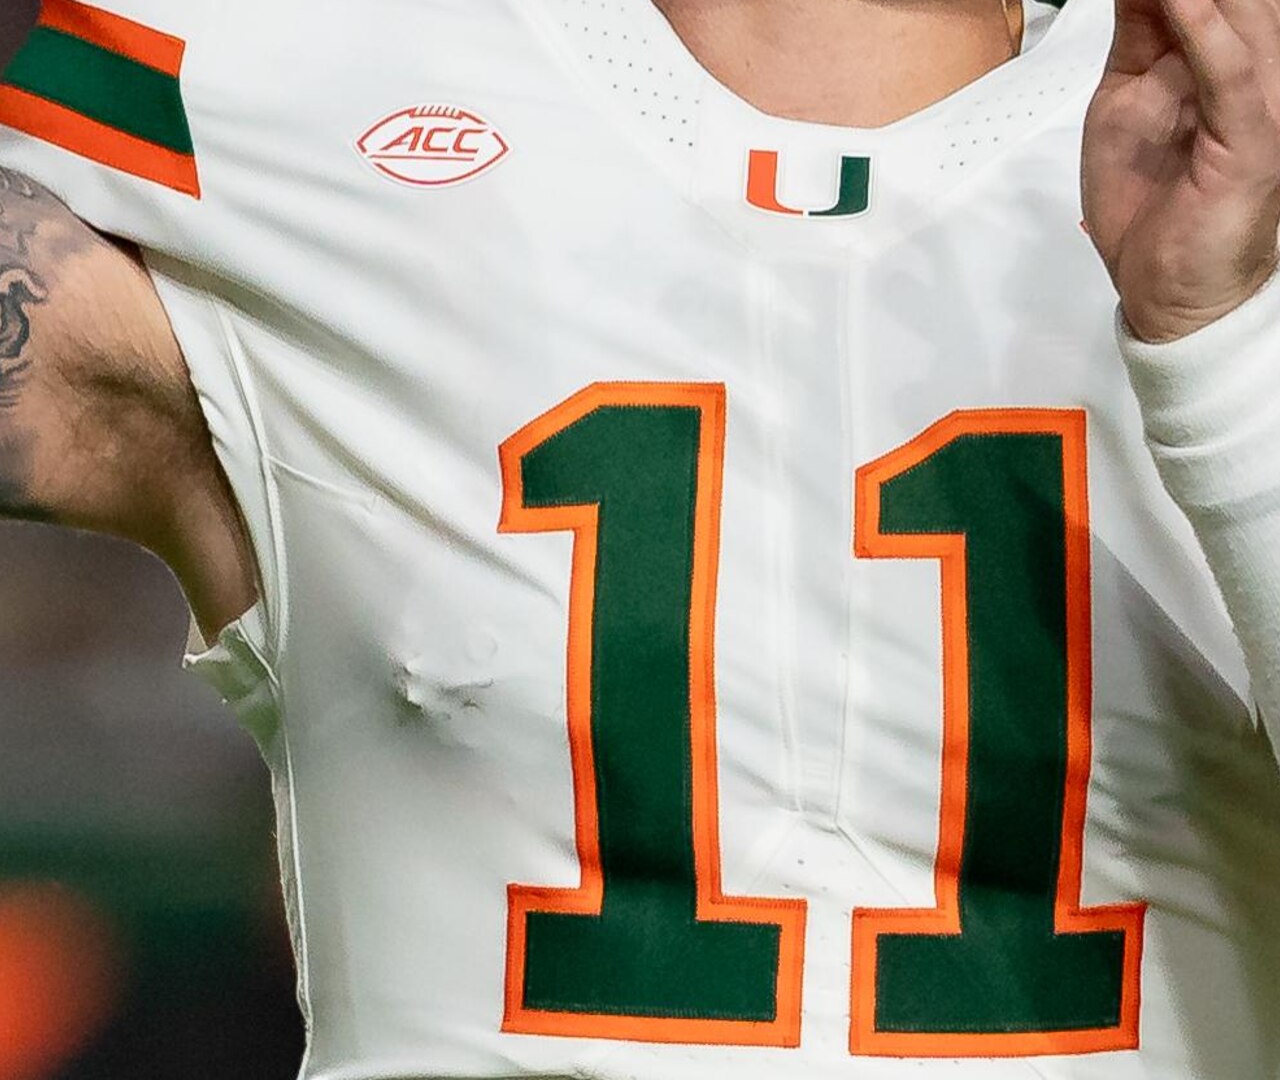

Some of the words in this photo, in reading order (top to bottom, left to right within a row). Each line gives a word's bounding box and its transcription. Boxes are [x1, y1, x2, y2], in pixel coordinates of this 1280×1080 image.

[379, 127, 489, 153] ACC
[746, 148, 871, 218] U
[497, 381, 1148, 1058] 11
